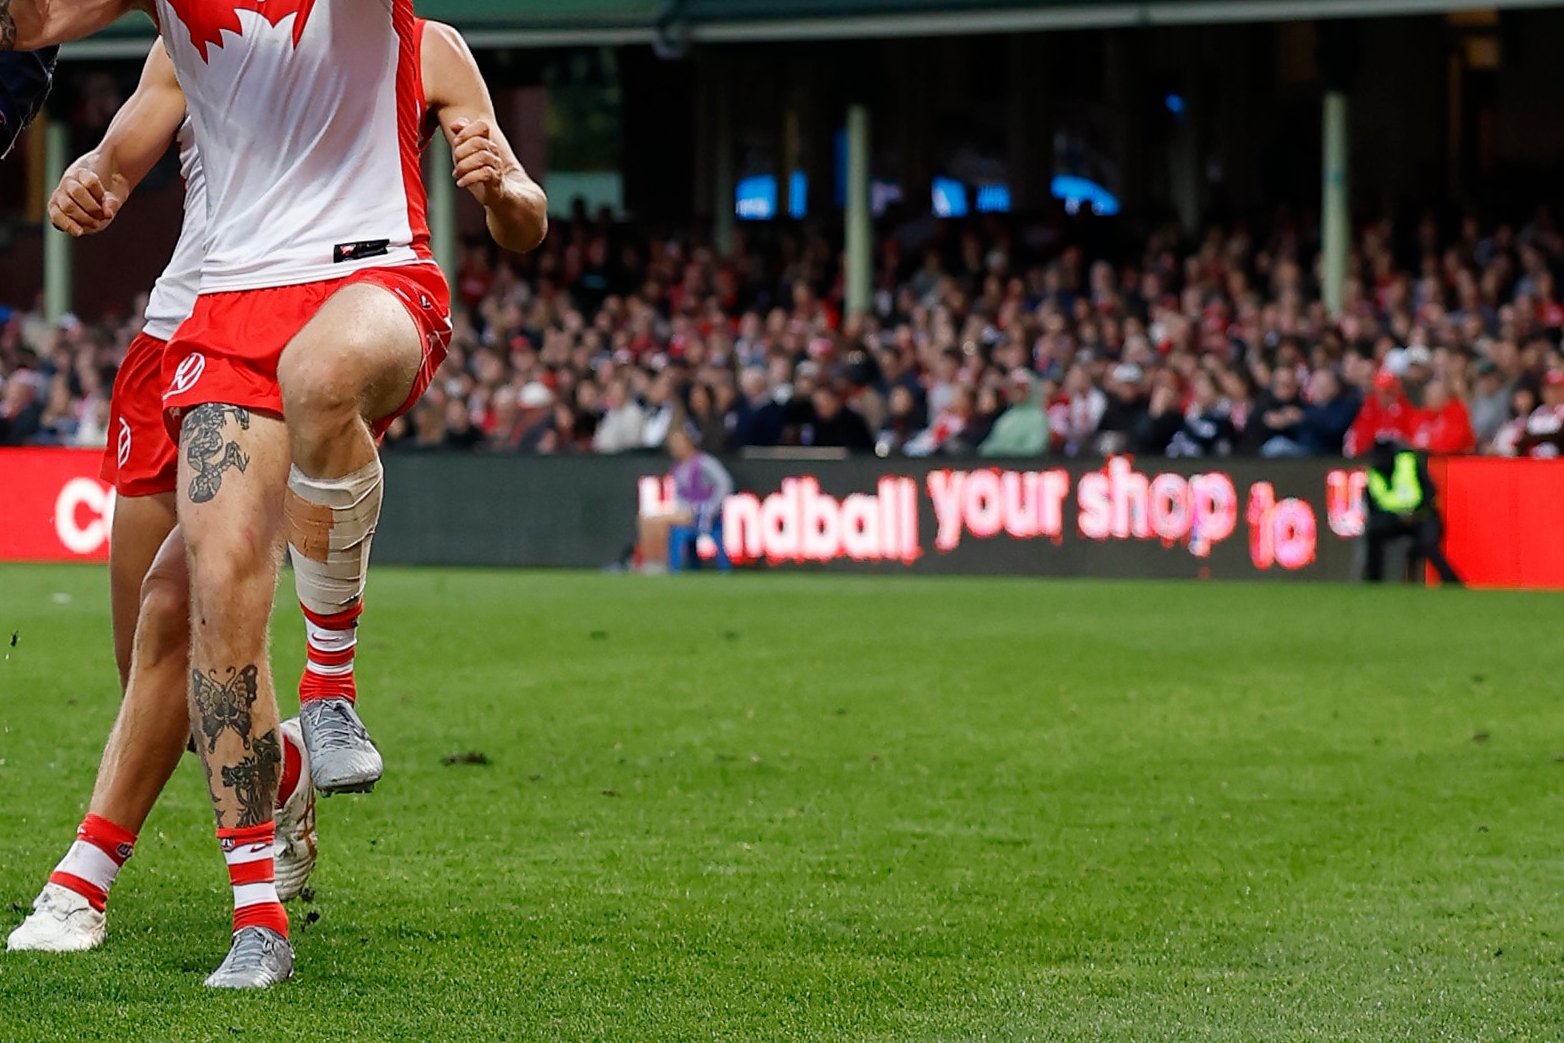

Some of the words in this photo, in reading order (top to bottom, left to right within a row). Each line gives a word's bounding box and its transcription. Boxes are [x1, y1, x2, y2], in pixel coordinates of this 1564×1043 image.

[638, 473, 923, 564] Hndball
[927, 466, 1069, 552] your
[1078, 453, 1236, 557] shop
[1246, 481, 1317, 570] to
[1327, 468, 1367, 538] u
